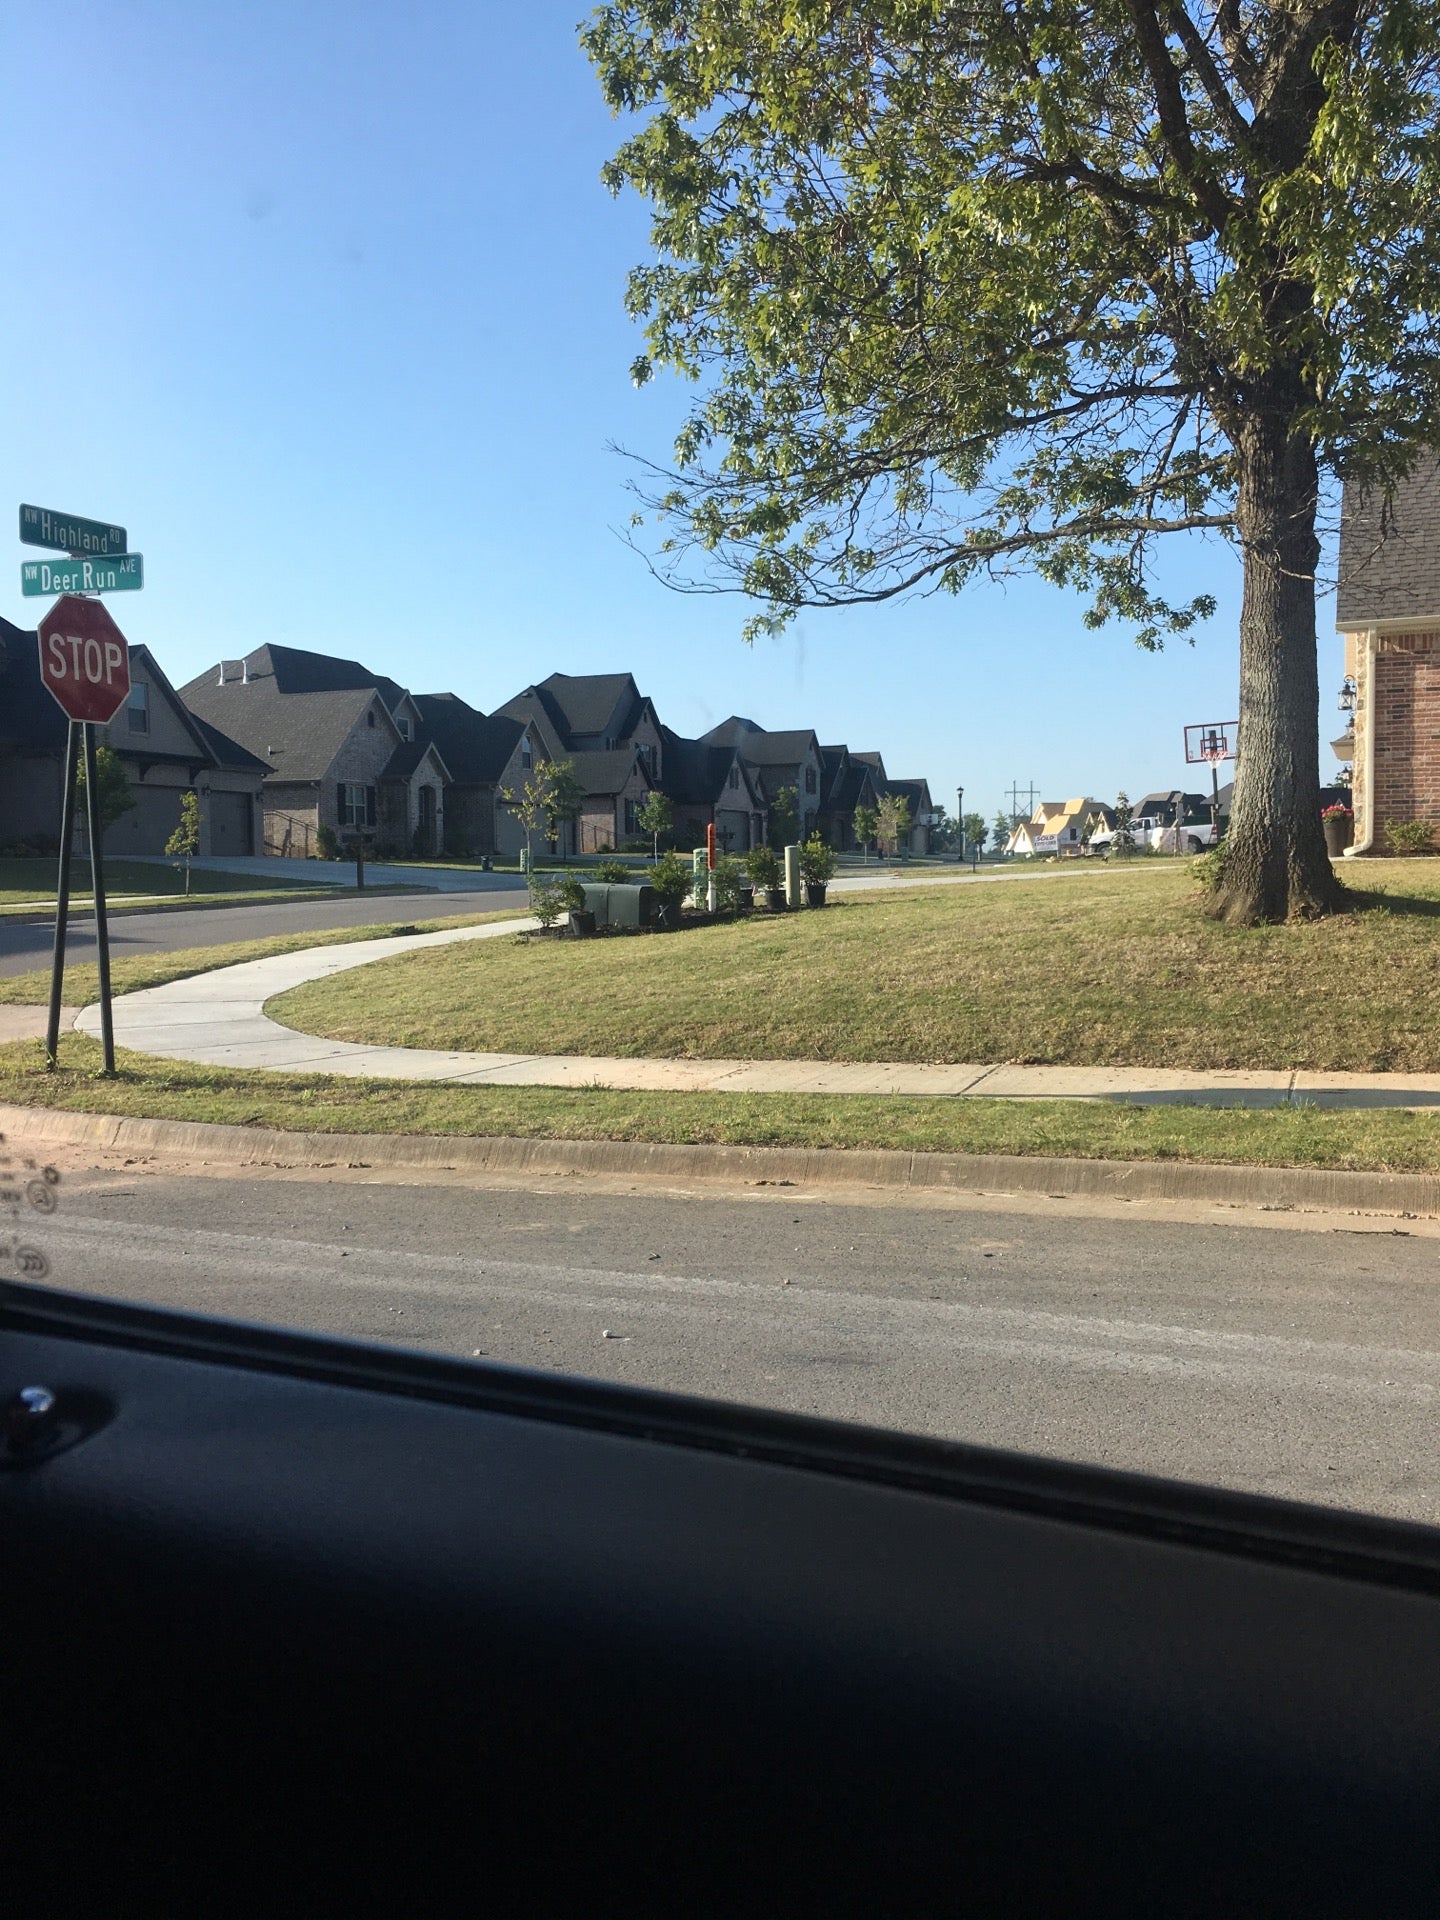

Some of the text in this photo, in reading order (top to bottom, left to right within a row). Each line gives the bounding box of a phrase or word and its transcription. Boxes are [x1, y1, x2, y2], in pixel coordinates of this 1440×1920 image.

[25, 509, 120, 553] NW Highland RD
[25, 559, 136, 591] NW Deer Run AVE
[48, 633, 122, 685] STOP
